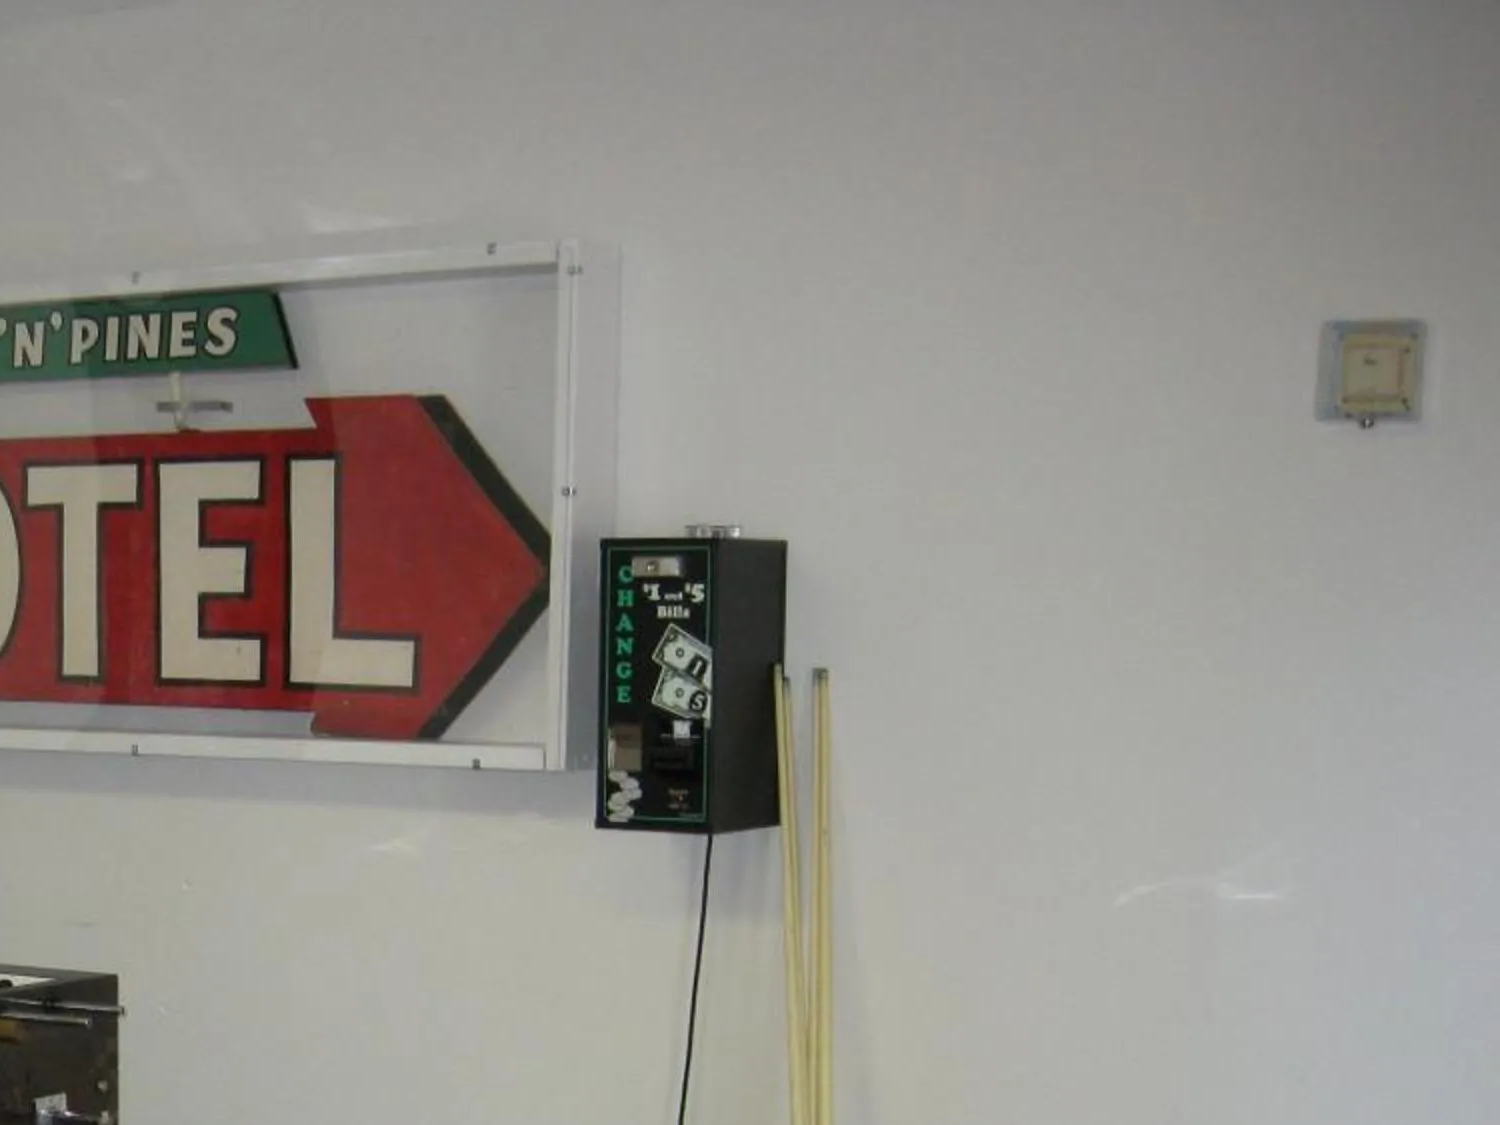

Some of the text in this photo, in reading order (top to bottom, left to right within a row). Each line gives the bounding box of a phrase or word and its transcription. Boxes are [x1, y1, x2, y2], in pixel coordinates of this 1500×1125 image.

[69, 306, 239, 365] PINES
[615, 564, 635, 704] CHANGE
[656, 605, 691, 619] Bills
